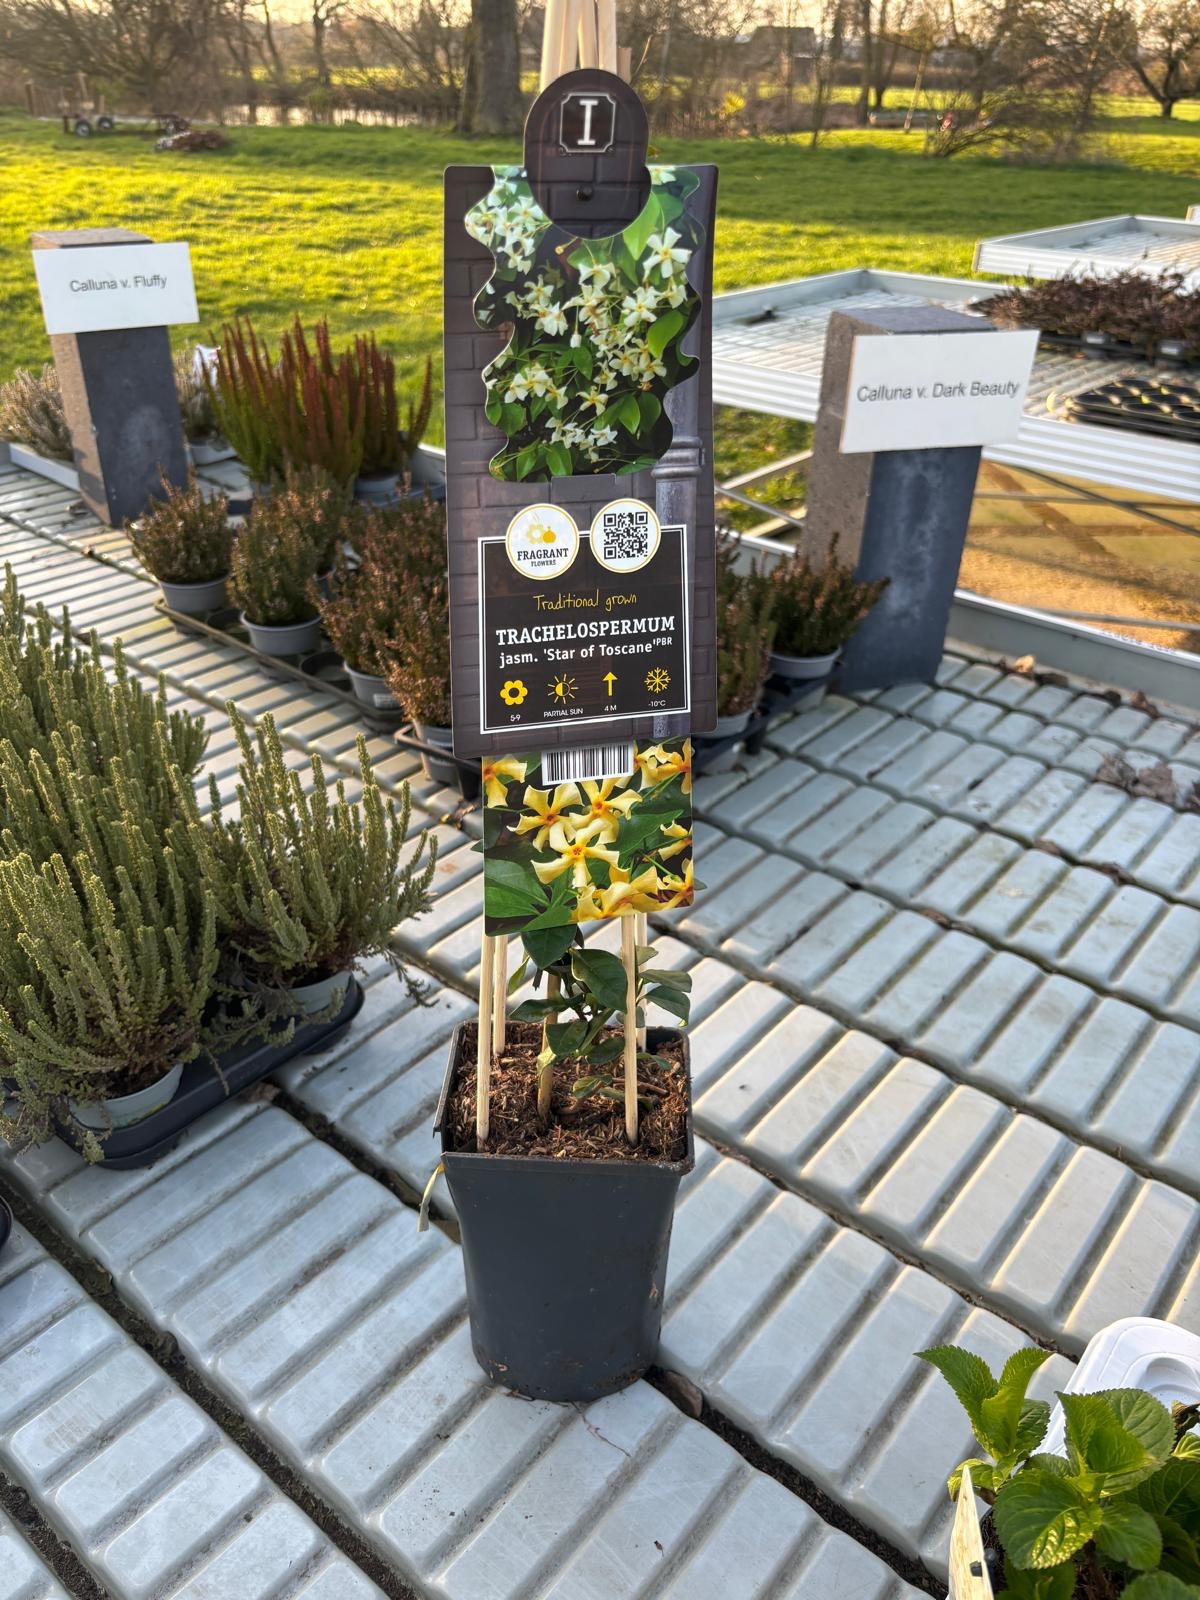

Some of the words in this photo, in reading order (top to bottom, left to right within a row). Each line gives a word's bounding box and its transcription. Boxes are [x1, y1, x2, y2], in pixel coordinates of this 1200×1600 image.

[69, 278, 118, 293] Calluna
[120, 280, 131, 290] v.
[133, 274, 168, 290] Fluffy
[856, 385, 913, 402] Calluna
[916, 387, 928, 400] v.
[931, 382, 967, 399] Dark
[970, 380, 1021, 399] Beauty
[517, 547, 569, 561] FRAGRANT
[530, 559, 557, 567] FLOWERS
[533, 588, 600, 612] Traditional
[605, 592, 637, 612] grown
[495, 615, 676, 646] TRACHELOSPERMUM
[499, 652, 539, 669] jasm.
[543, 647, 576, 662] 'Star
[580, 644, 595, 659] of
[543, 708, 569, 718] PARTIAL
[569, 707, 584, 716] SUN
